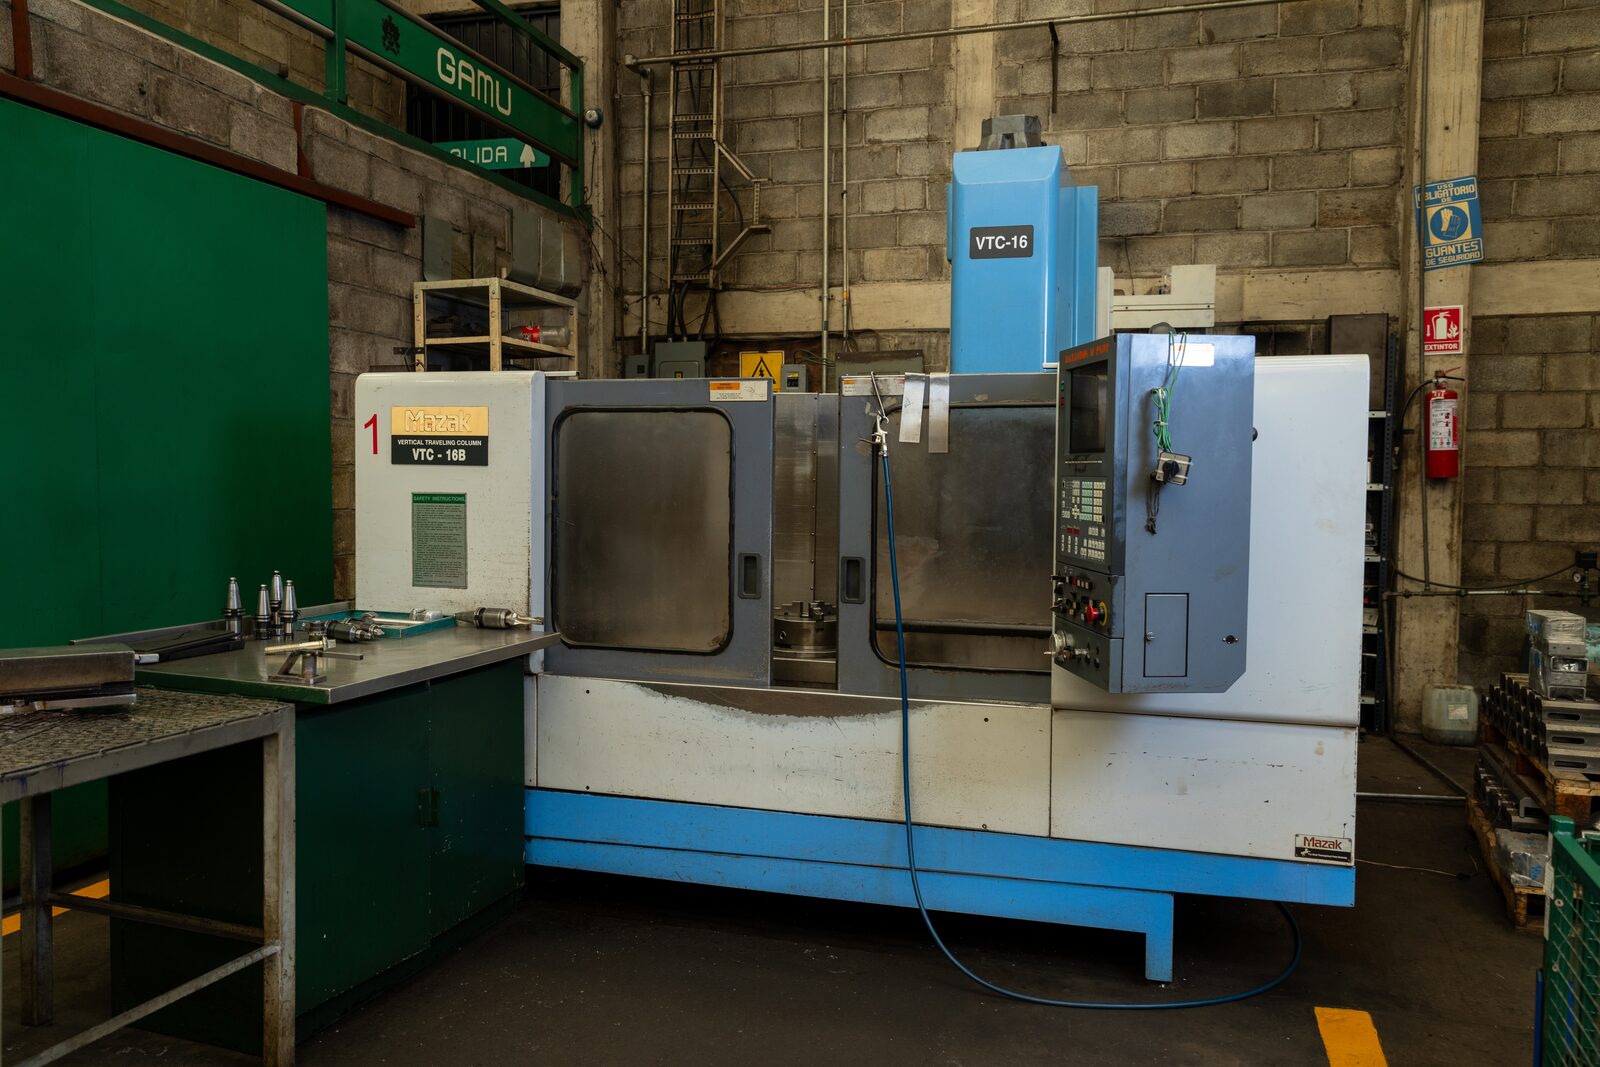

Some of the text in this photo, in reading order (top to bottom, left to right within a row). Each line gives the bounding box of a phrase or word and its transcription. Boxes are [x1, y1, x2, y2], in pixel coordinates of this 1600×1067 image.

[437, 47, 512, 116] GAMU
[450, 146, 507, 164] LIDA
[1437, 182, 1453, 190] USO
[975, 235, 1028, 250] VTC-16
[1425, 241, 1479, 258] GUANTES
[1438, 251, 1480, 265] SEGURIDAD
[1424, 341, 1458, 351] EXTINTOR
[405, 409, 472, 432] Mazak
[364, 413, 378, 455] 1
[412, 448, 434, 461] VTC
[446, 449, 466, 461] 16B
[1303, 836, 1342, 850] Mazak
